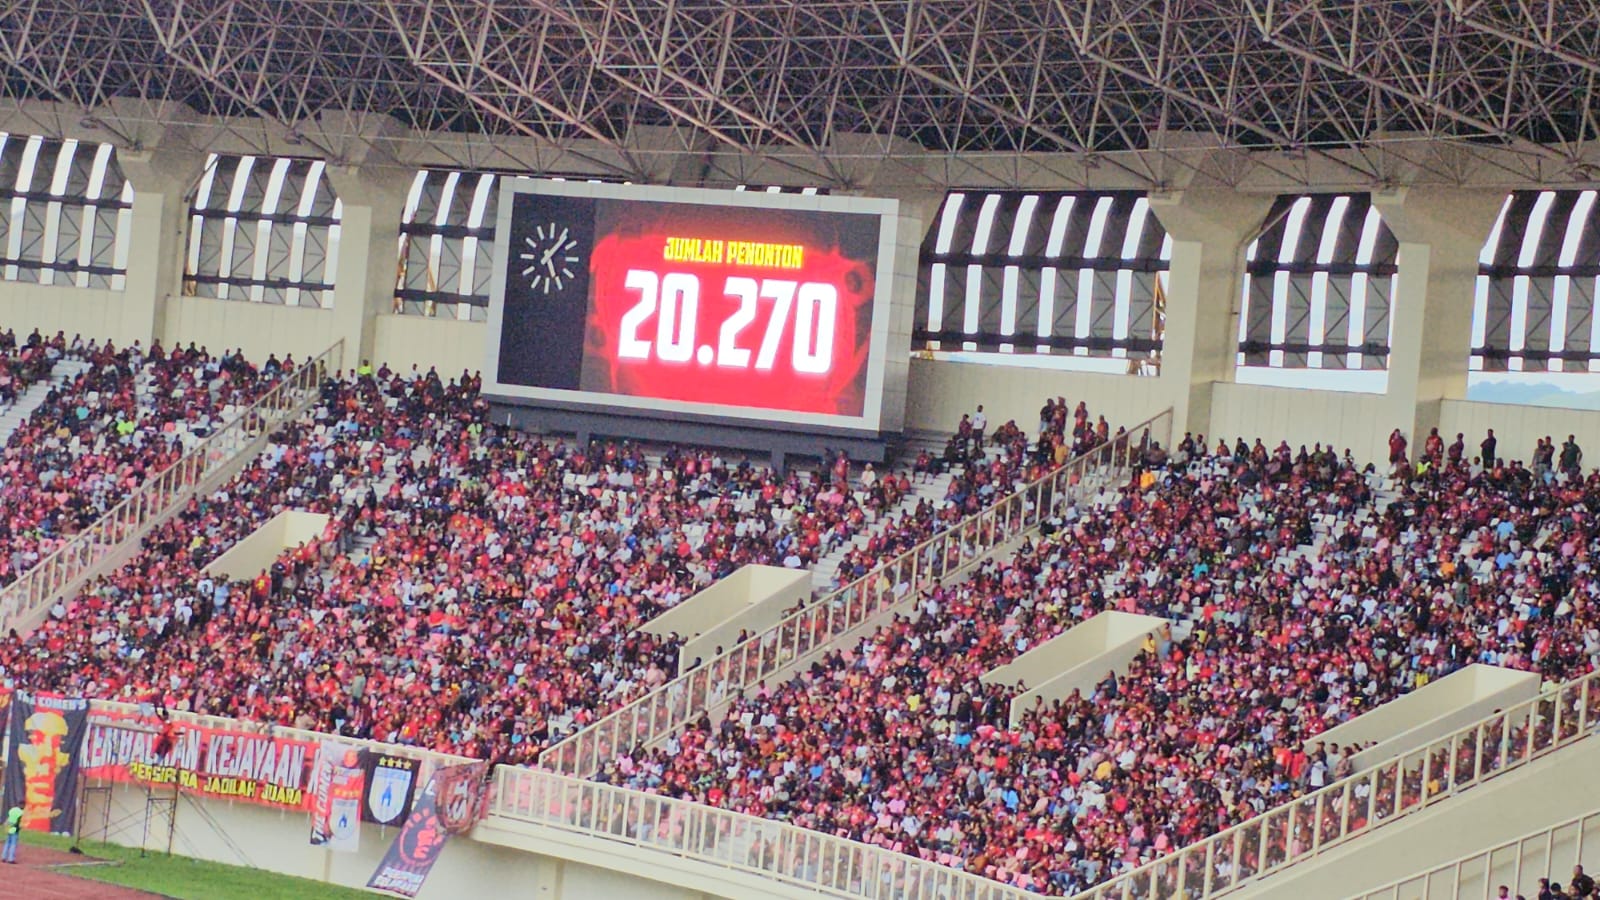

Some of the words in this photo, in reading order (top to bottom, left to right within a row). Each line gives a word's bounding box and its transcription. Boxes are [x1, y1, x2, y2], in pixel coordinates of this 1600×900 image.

[664, 237, 723, 263] JUMLAH
[726, 240, 803, 269] PENONTON
[618, 269, 837, 374] 20.270
[129, 762, 198, 790] PERSIPRA
[203, 777, 256, 798] JADILAH
[261, 784, 302, 805] JUARA
[206, 735, 306, 790] KEJAYAAN
